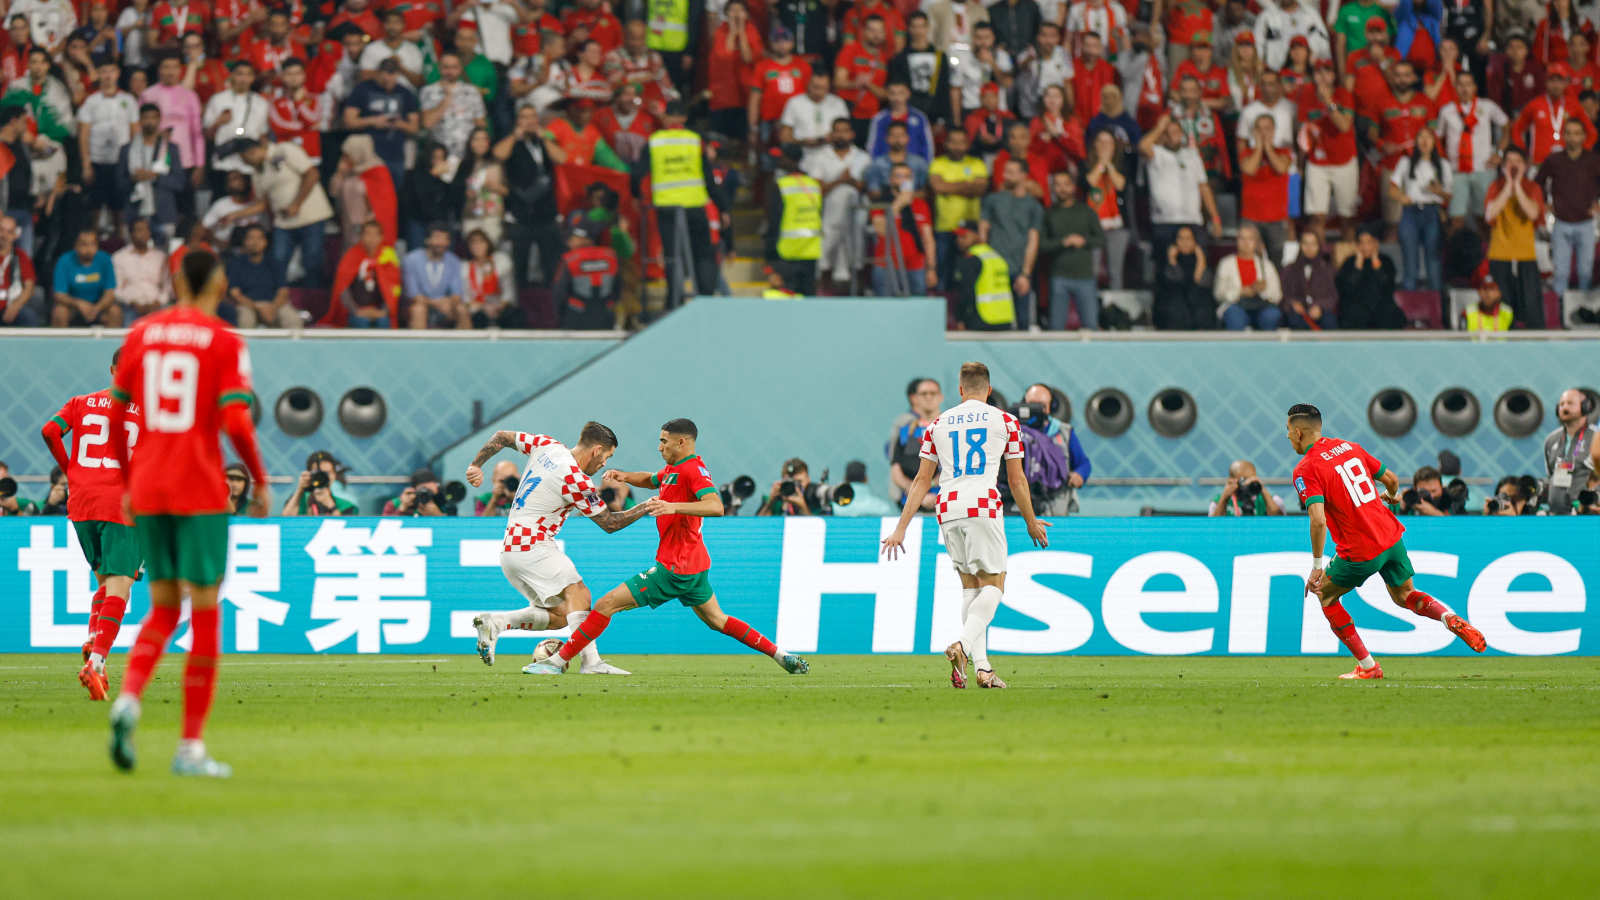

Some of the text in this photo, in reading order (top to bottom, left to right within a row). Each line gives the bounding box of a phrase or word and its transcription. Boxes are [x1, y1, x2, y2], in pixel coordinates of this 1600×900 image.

[87, 397, 96, 407] EL
[143, 350, 199, 433] 19
[948, 427, 988, 478] 18
[1334, 457, 1377, 508] 18
[776, 516, 1589, 655] Hisense
